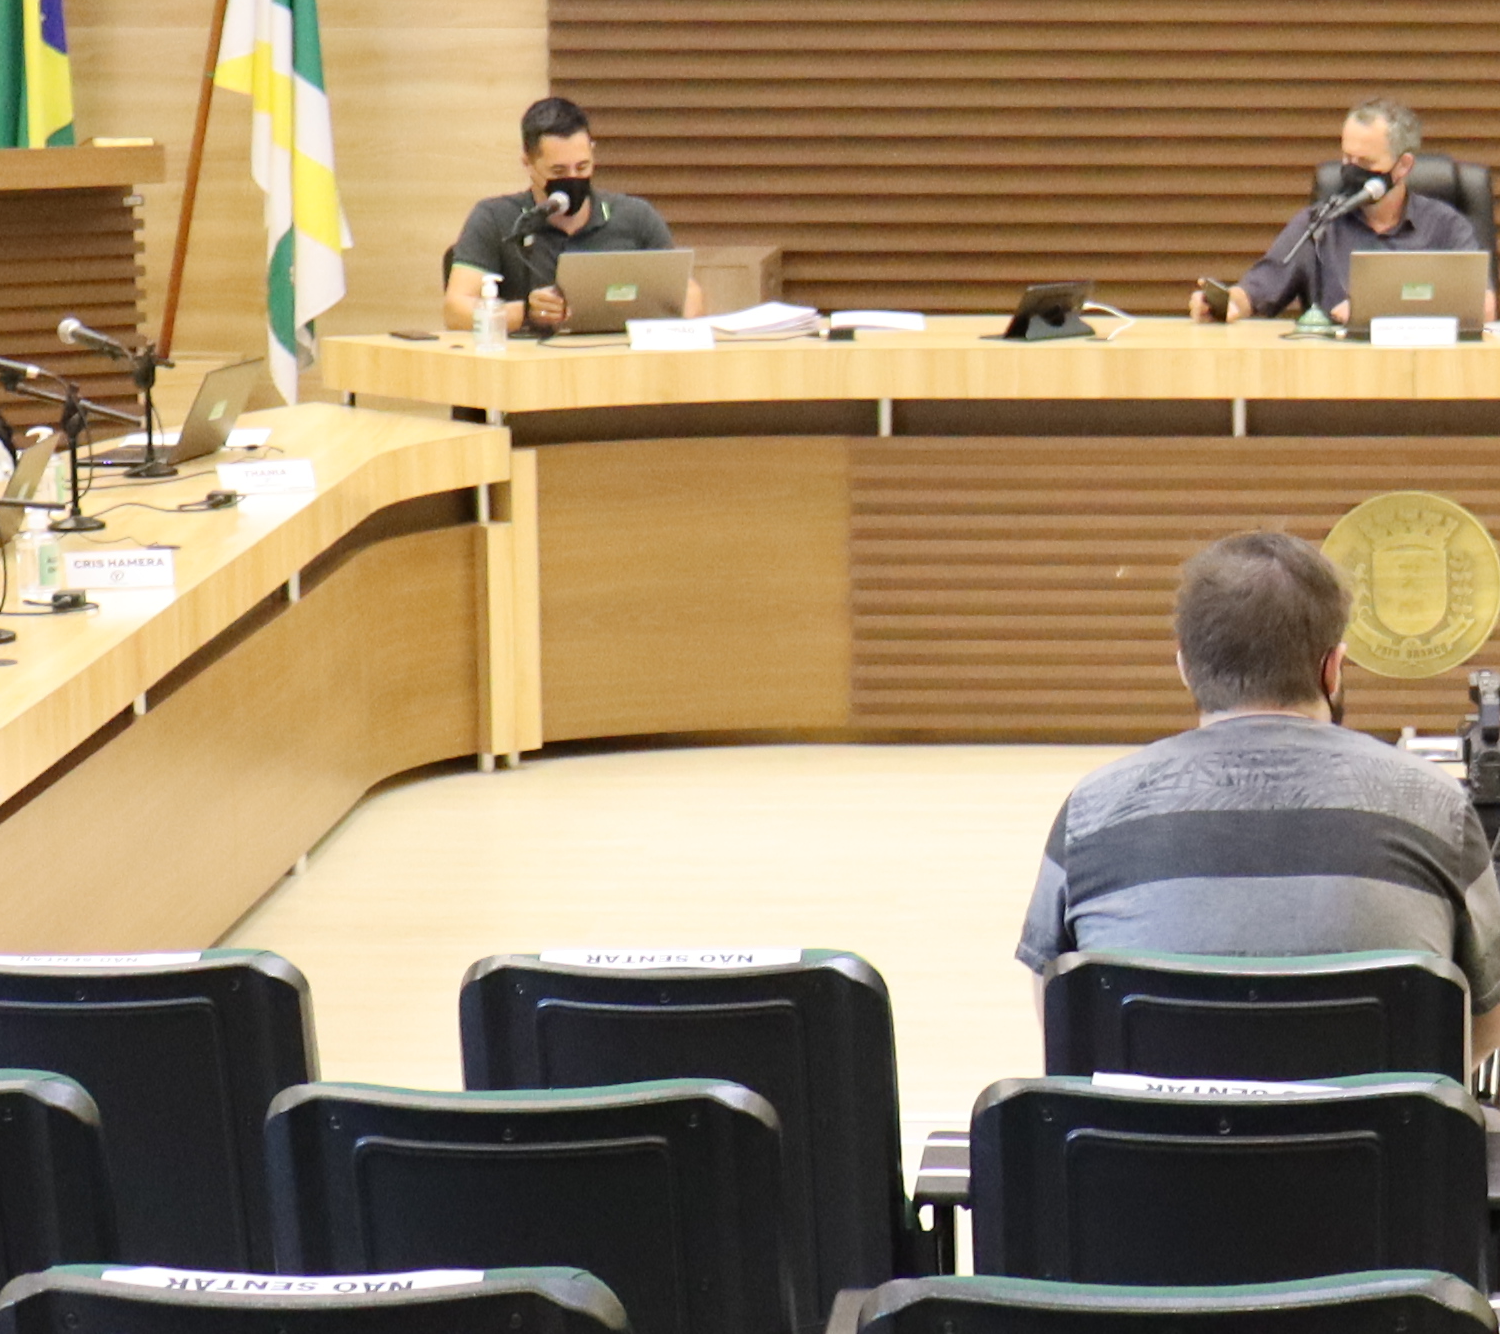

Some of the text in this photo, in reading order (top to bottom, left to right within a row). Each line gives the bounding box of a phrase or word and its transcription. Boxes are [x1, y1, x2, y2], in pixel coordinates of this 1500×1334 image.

[73, 558, 165, 569] CRIS HAMERA
[587, 954, 689, 964] SENTAR
[166, 1277, 316, 1292] SENTAR
